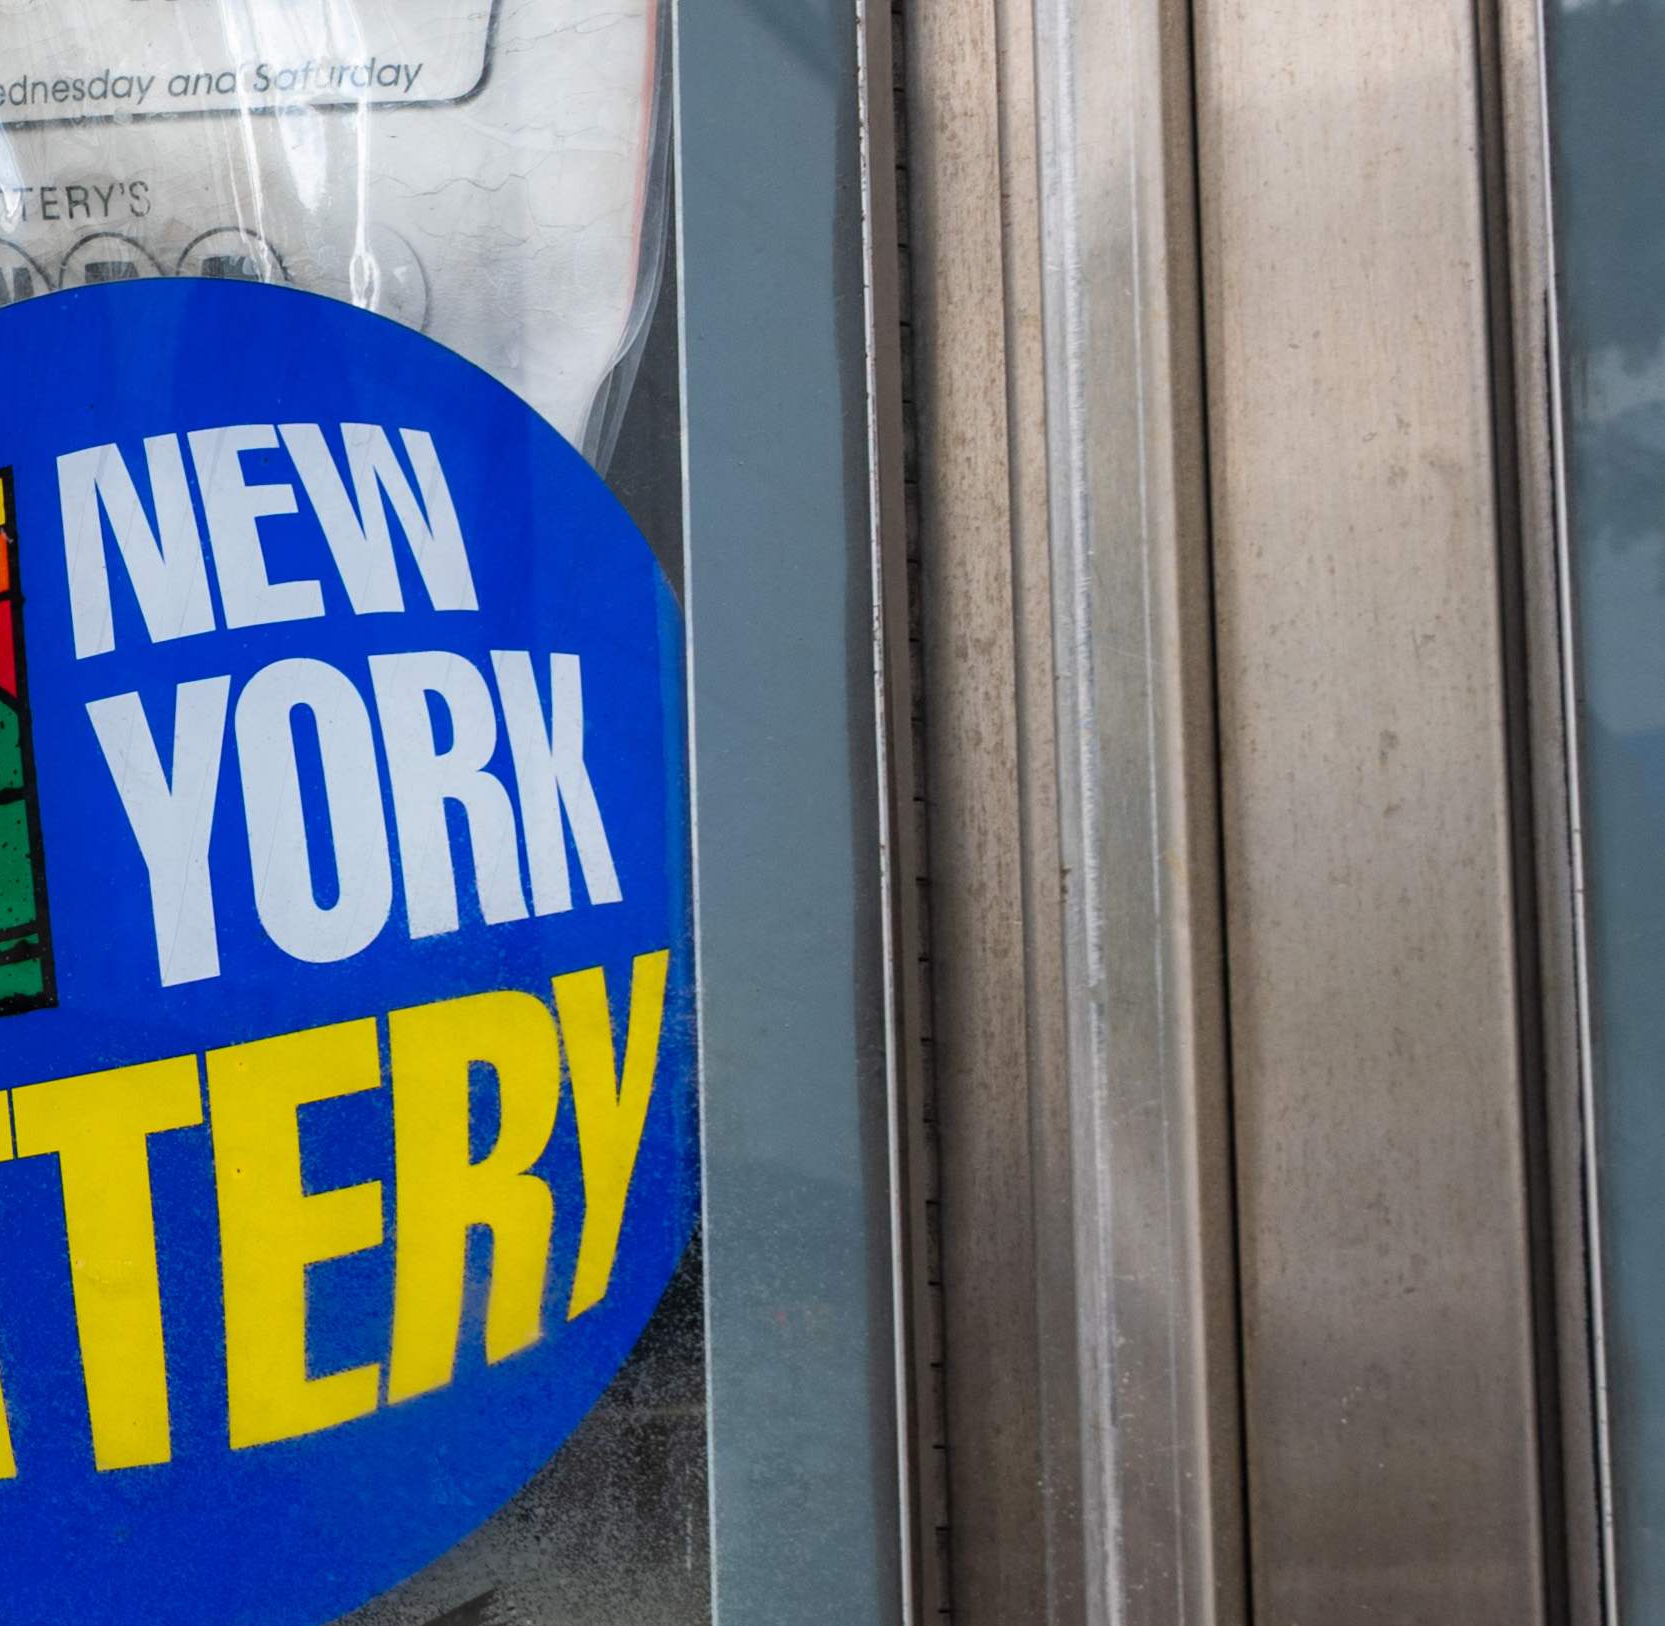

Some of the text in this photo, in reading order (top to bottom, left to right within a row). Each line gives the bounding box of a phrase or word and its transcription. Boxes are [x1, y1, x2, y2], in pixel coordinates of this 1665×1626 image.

[167, 65, 237, 97] and
[253, 57, 424, 93] Saturday
[56, 423, 480, 659] NEW
[86, 650, 623, 988] YORK
